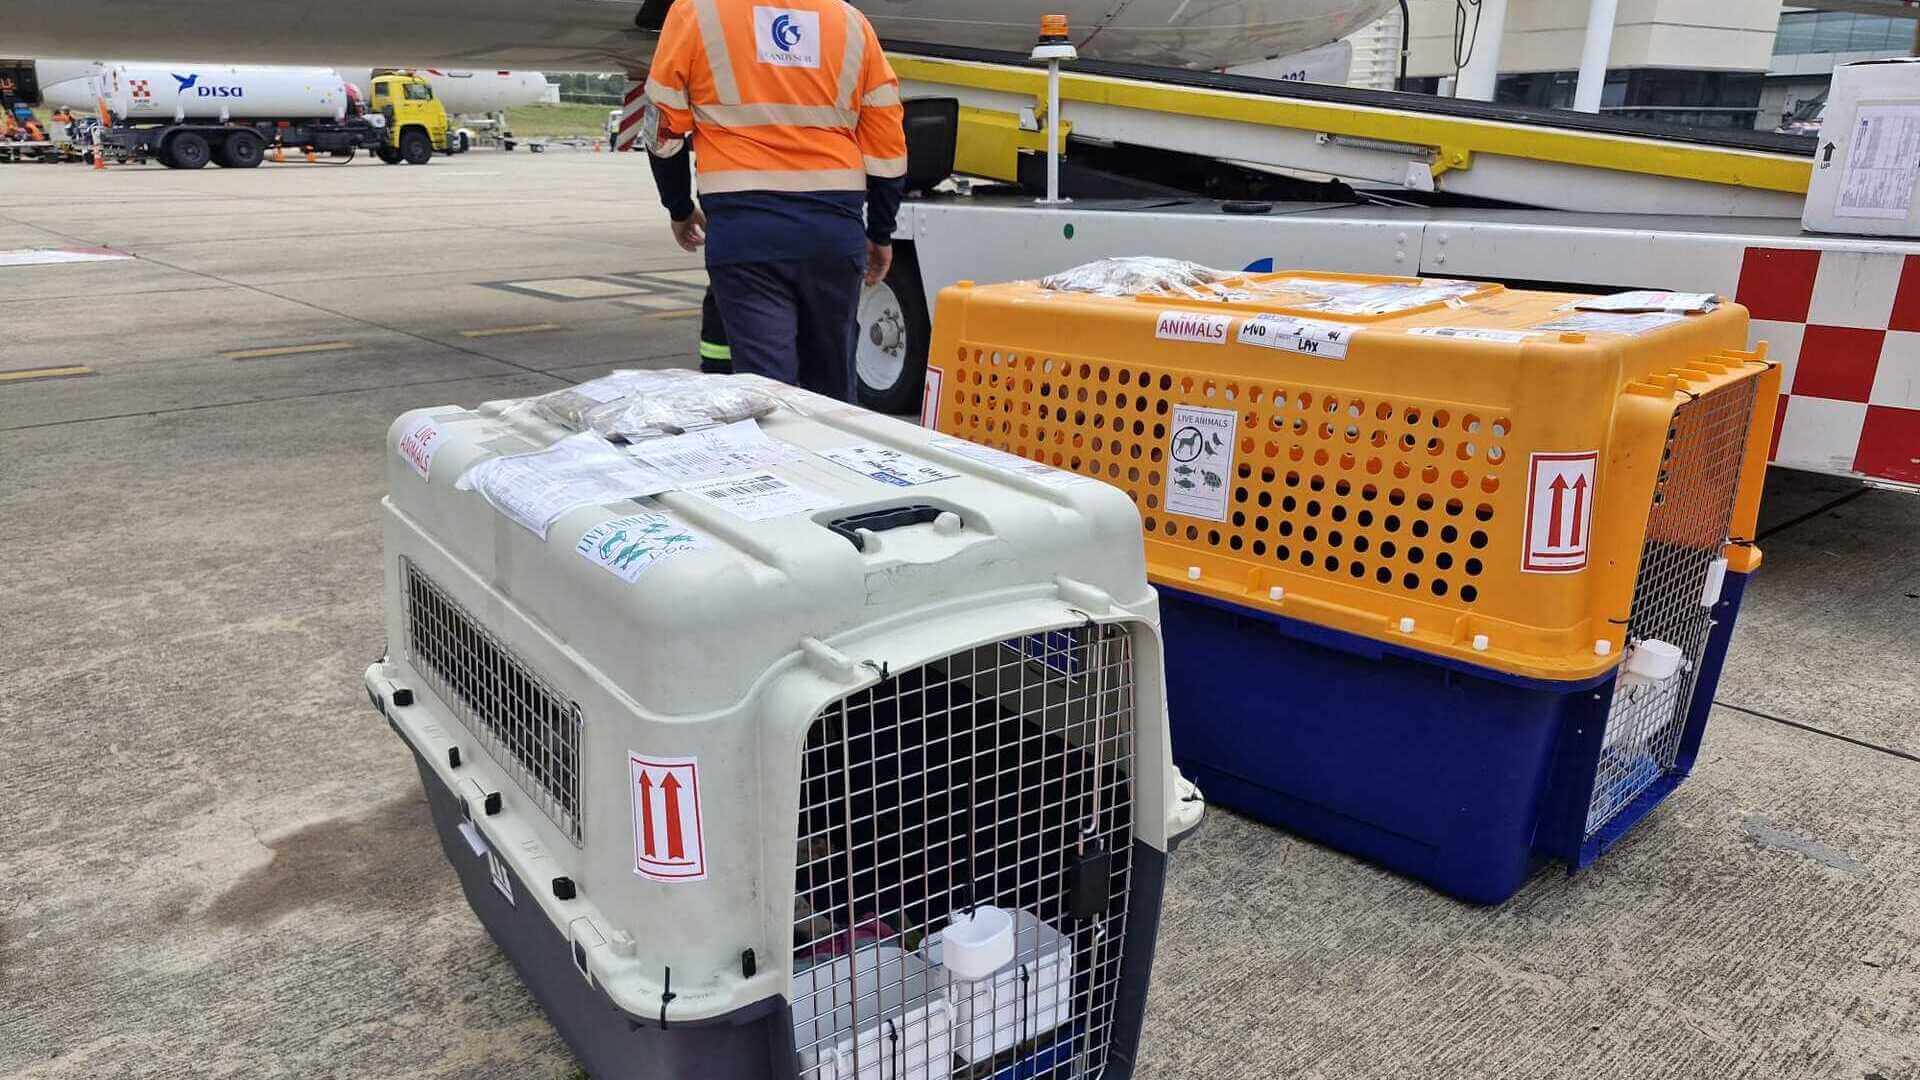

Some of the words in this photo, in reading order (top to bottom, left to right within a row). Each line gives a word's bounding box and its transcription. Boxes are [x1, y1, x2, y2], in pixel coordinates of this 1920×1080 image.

[1159, 319, 1224, 338] ANIMALS
[1242, 323, 1267, 337] MVD
[1298, 339, 1319, 352] LAX
[1177, 413, 1194, 424] LIVE
[1195, 415, 1228, 428] ANIMALS
[578, 527, 605, 553] LIVE
